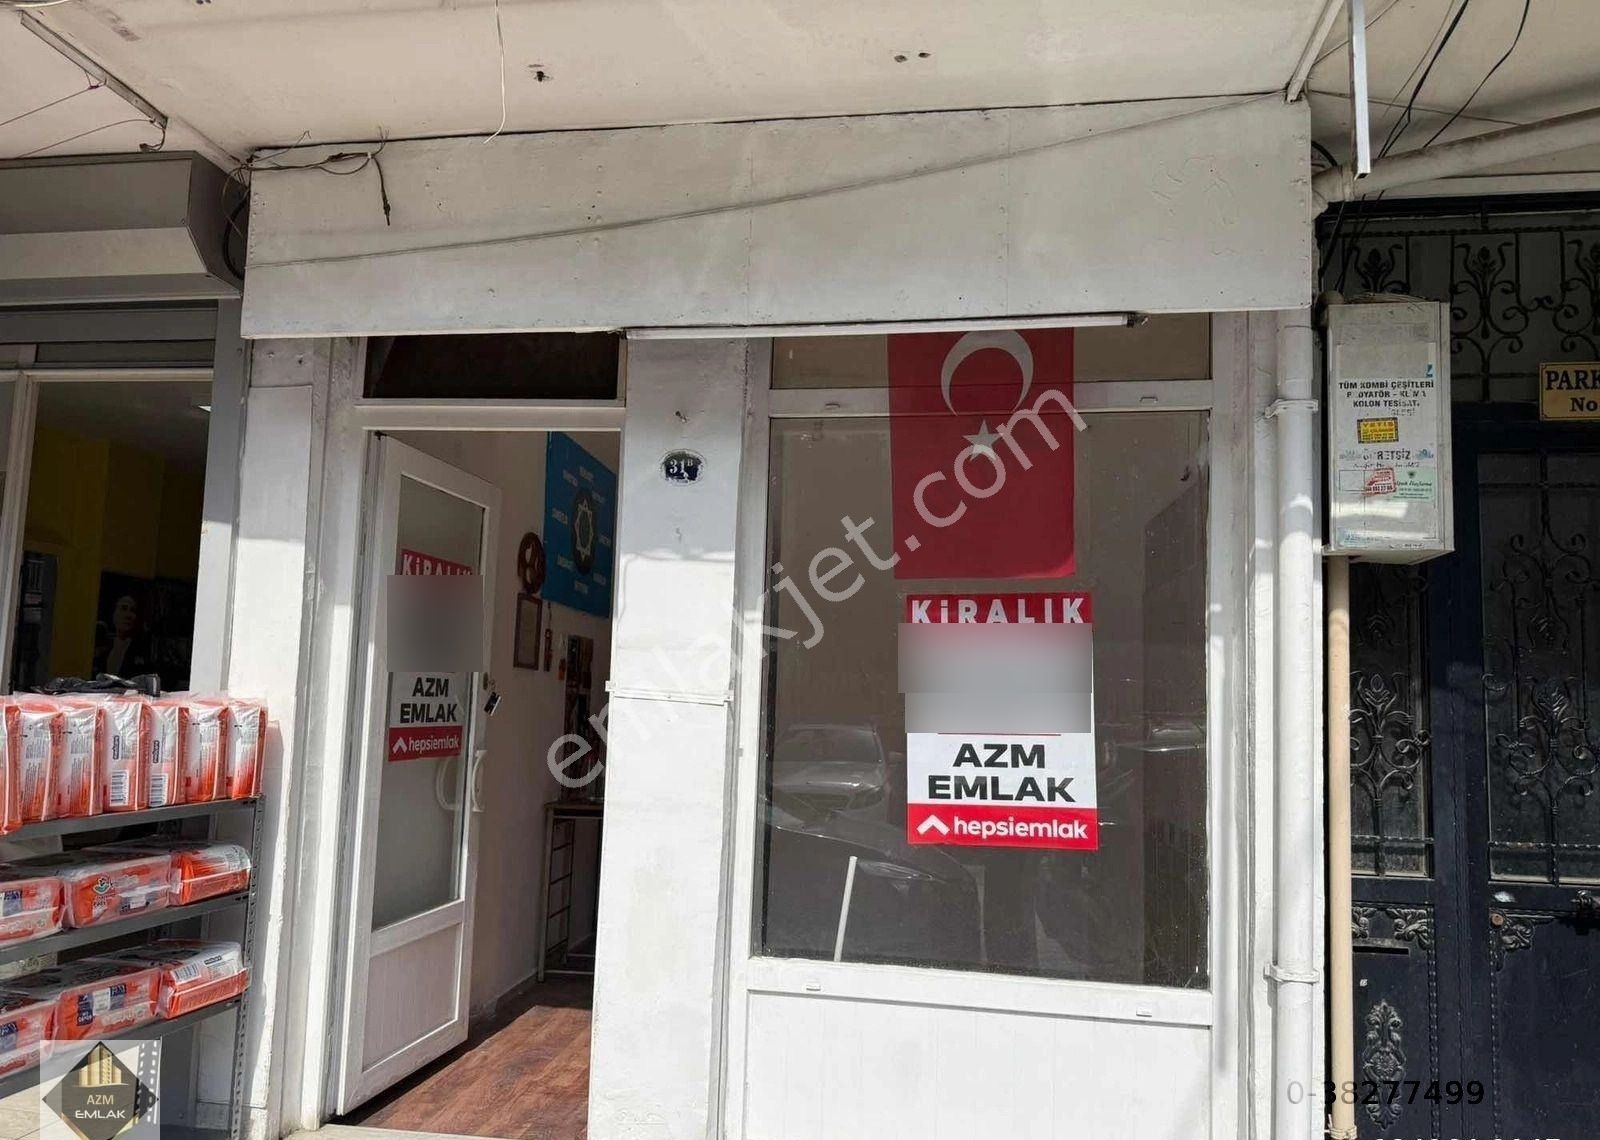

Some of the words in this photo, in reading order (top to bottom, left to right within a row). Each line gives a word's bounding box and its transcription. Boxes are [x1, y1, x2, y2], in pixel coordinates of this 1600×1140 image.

[1338, 380, 1358, 389] TÜM
[412, 677, 450, 698] AZM
[400, 703, 458, 724] EMLAK
[408, 735, 460, 754] hepsiemlak
[952, 743, 1046, 769] AZM
[928, 775, 1076, 803] EMLAK
[953, 815, 1089, 839] hepsiemlak
